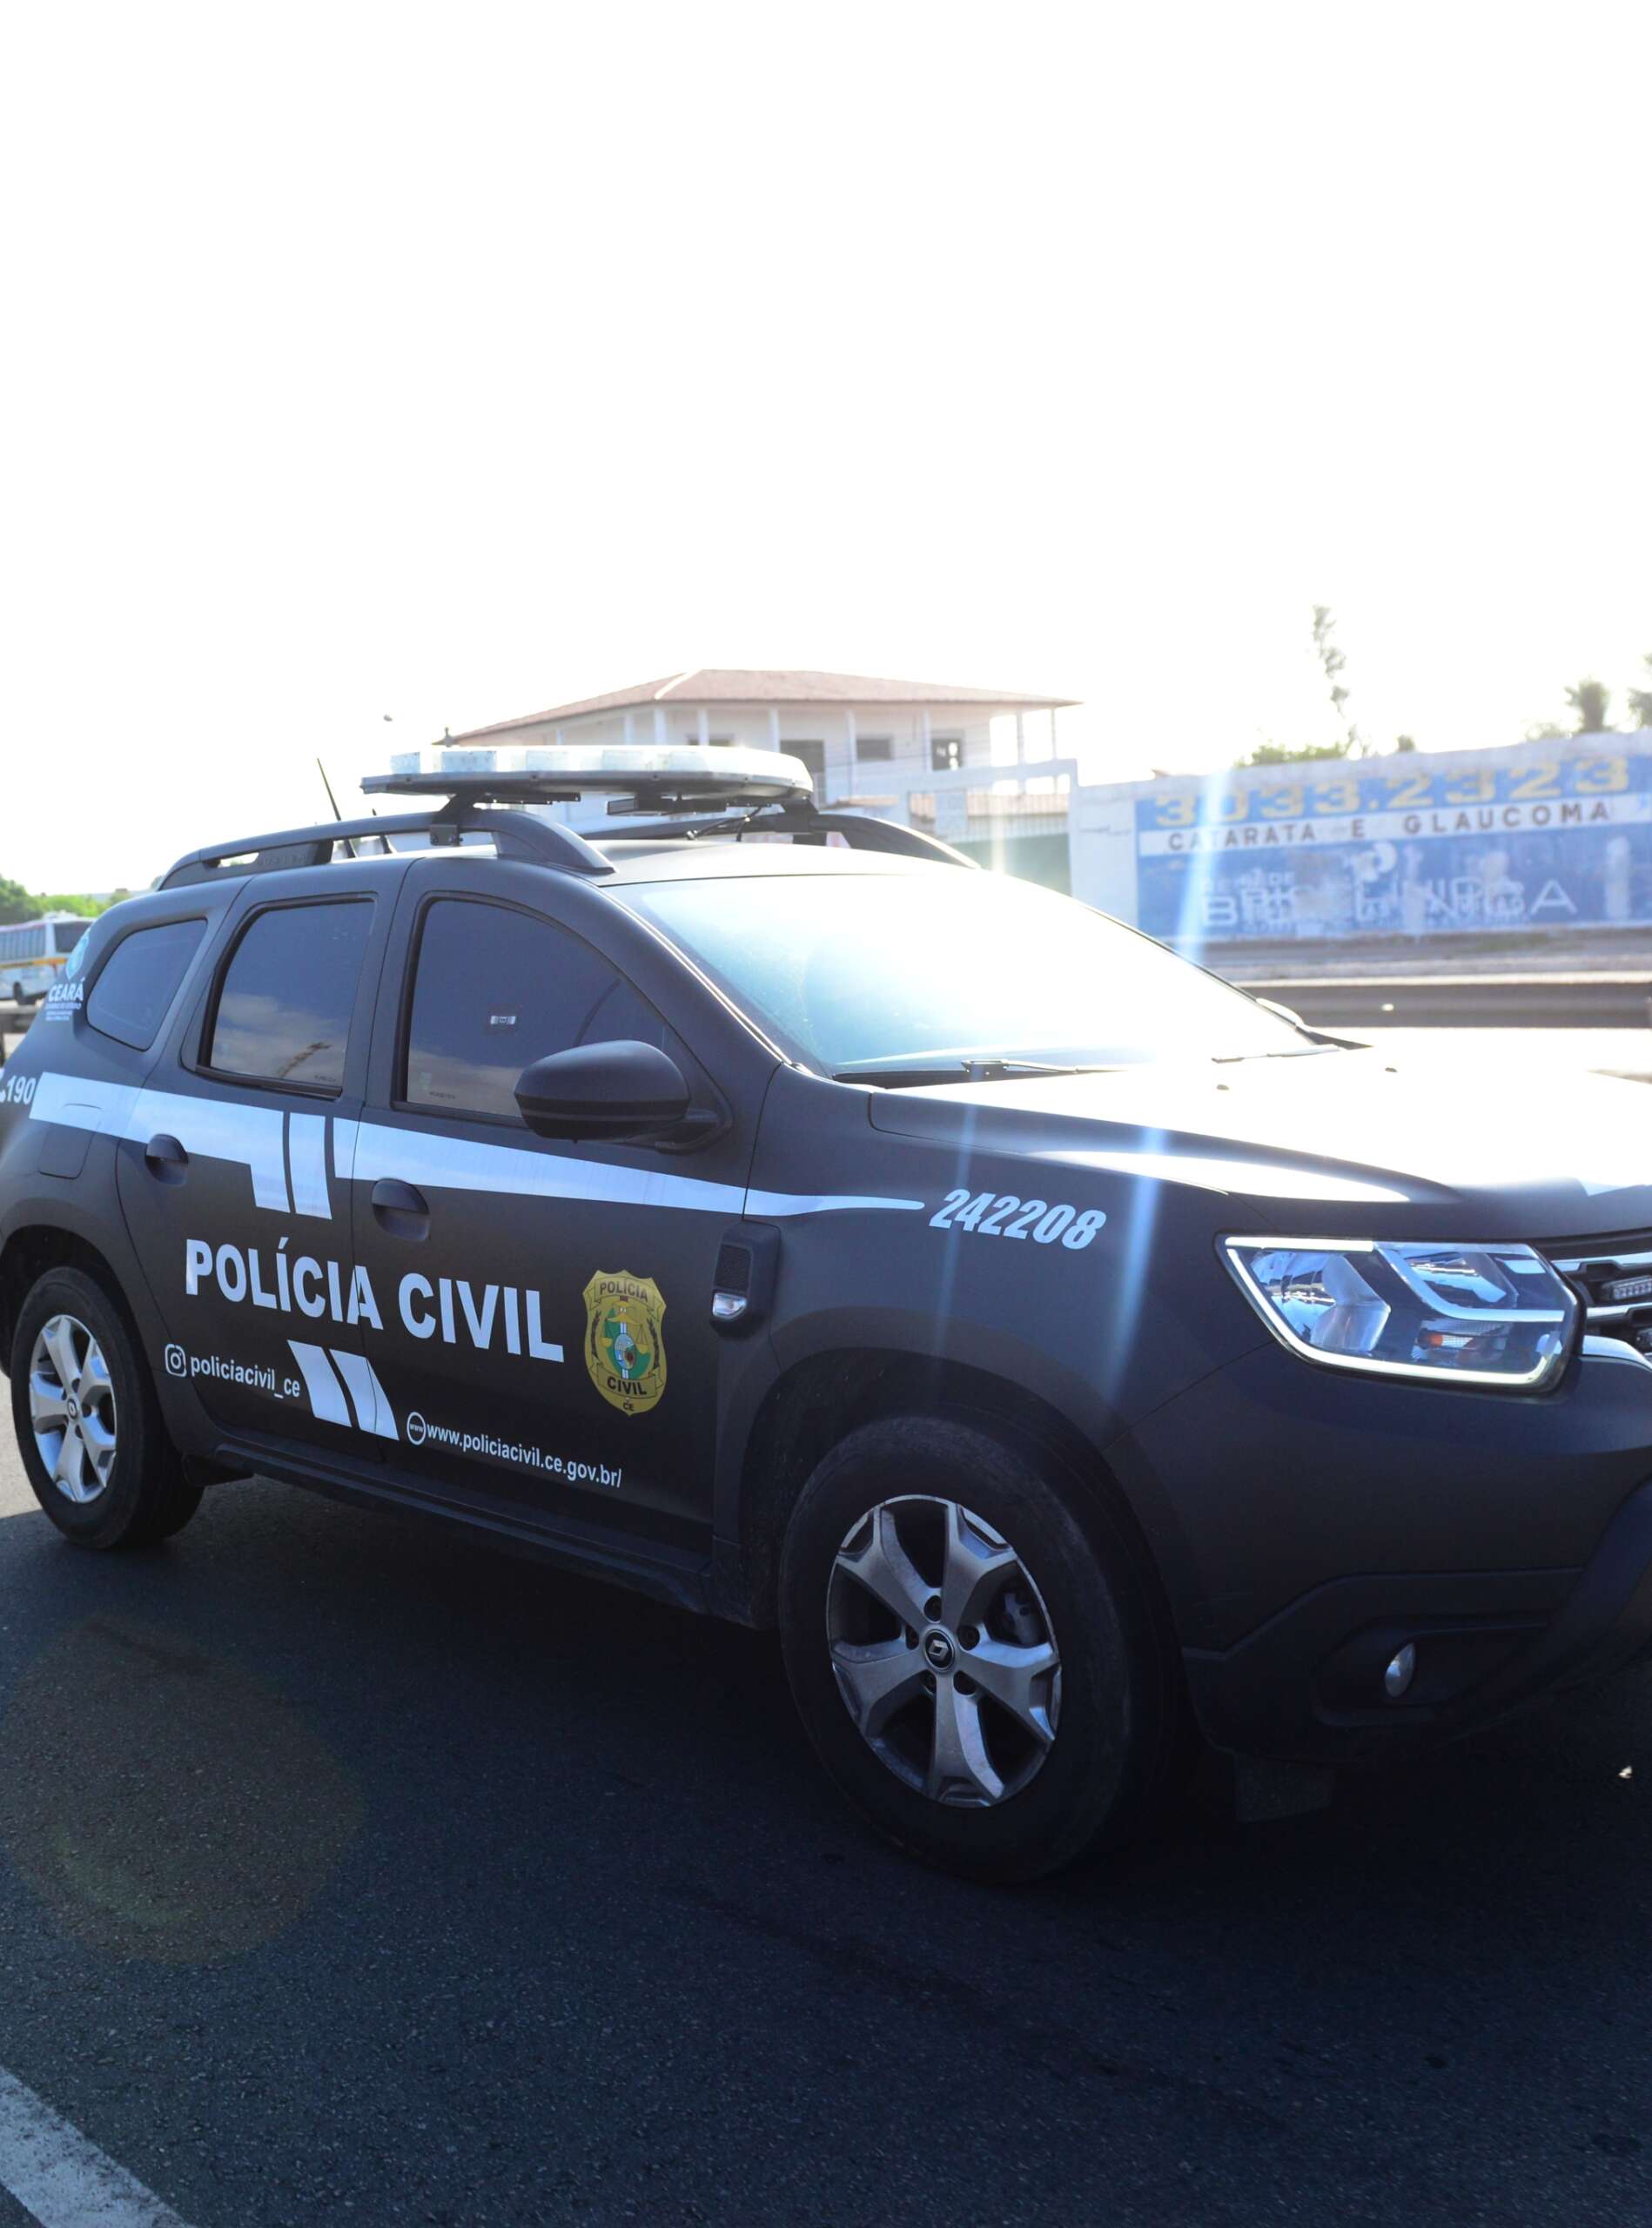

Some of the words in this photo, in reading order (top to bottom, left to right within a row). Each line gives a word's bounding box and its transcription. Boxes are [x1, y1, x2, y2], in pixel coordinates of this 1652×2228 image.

[1352, 818, 1366, 838] E
[1403, 802, 1610, 835] GLAUCOMA
[48, 976, 85, 1002] CEARÁ
[7, 1075, 37, 1104] 190
[929, 1189, 1107, 1250] 242208
[185, 1237, 384, 1330] POLÍCIA
[398, 1272, 564, 1363] CIVIL
[190, 1355, 300, 1399] policiacivil_ce
[607, 1377, 648, 1396] CIVIL
[426, 1423, 622, 1488] www.policiacivil.ce.gov.br/
